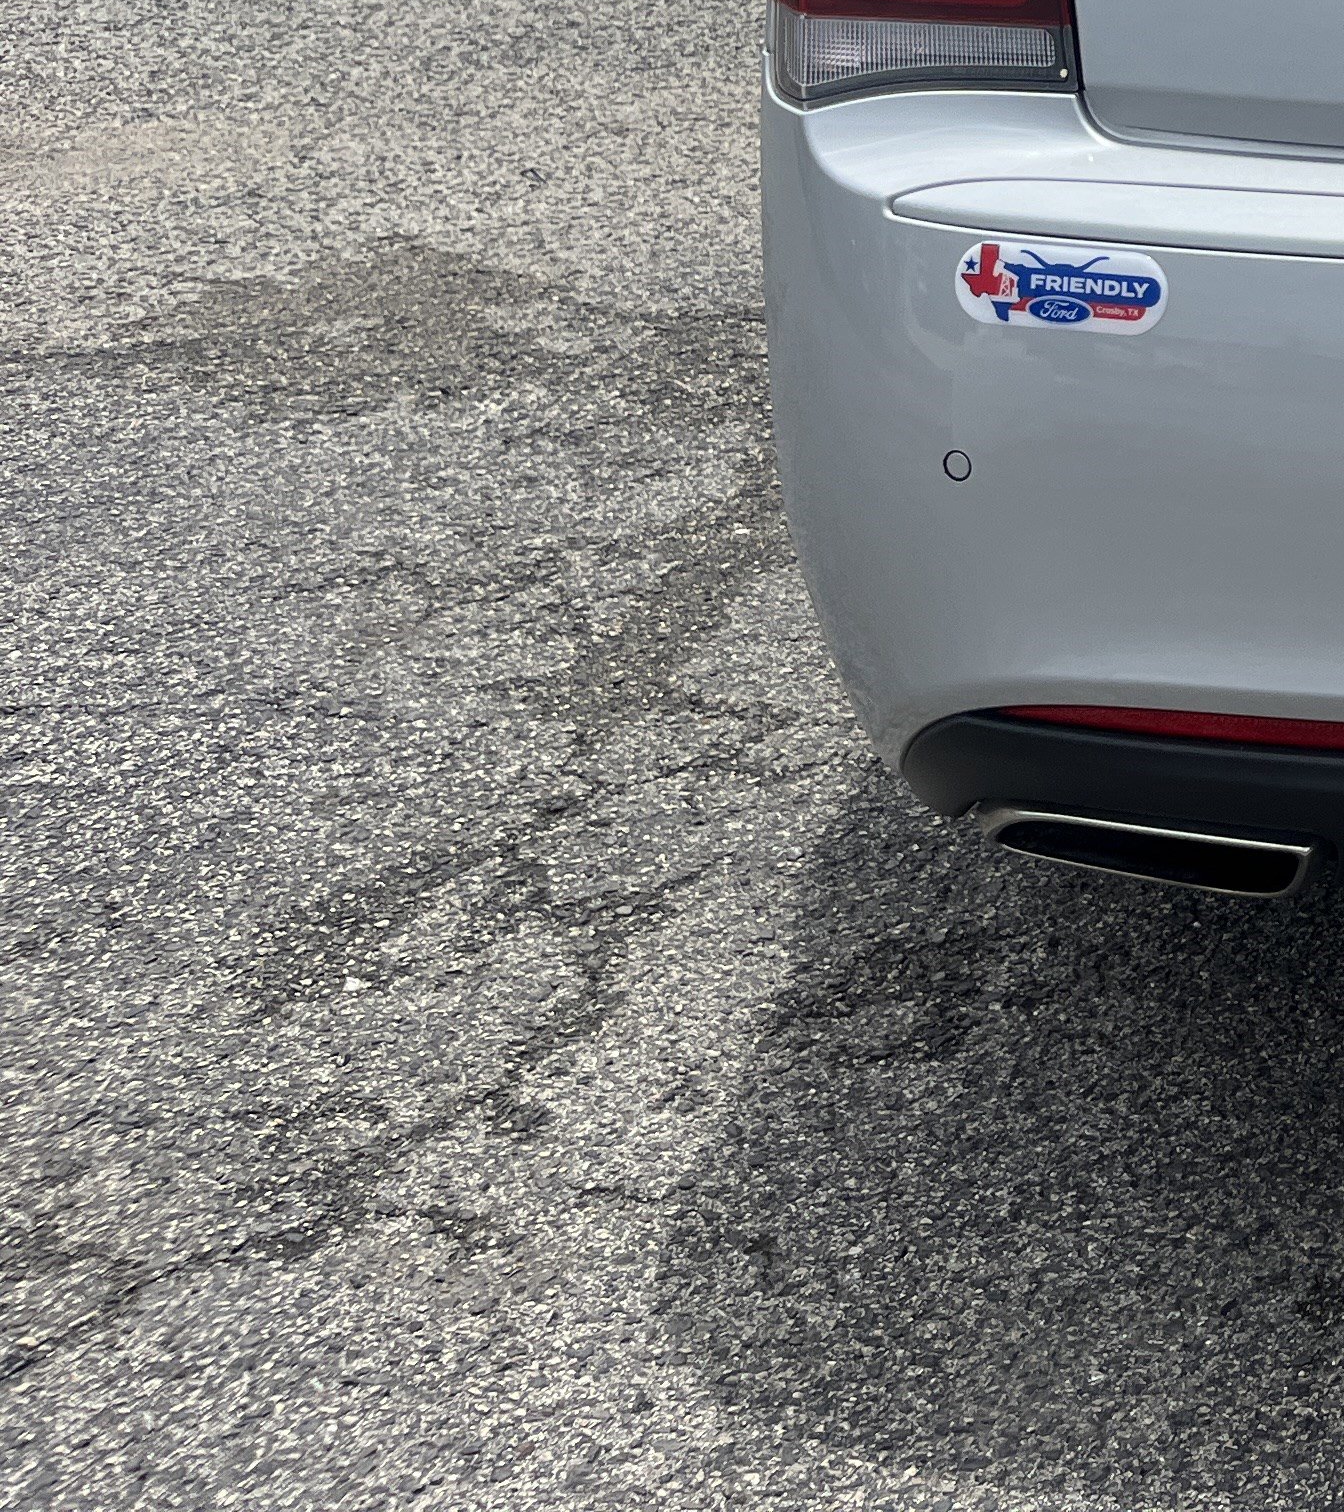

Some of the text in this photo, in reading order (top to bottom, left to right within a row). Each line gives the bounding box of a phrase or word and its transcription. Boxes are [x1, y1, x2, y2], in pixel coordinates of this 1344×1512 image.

[1029, 274, 1151, 299] FRIENDLY
[1039, 299, 1080, 321] Ford
[1128, 308, 1139, 317] TX
